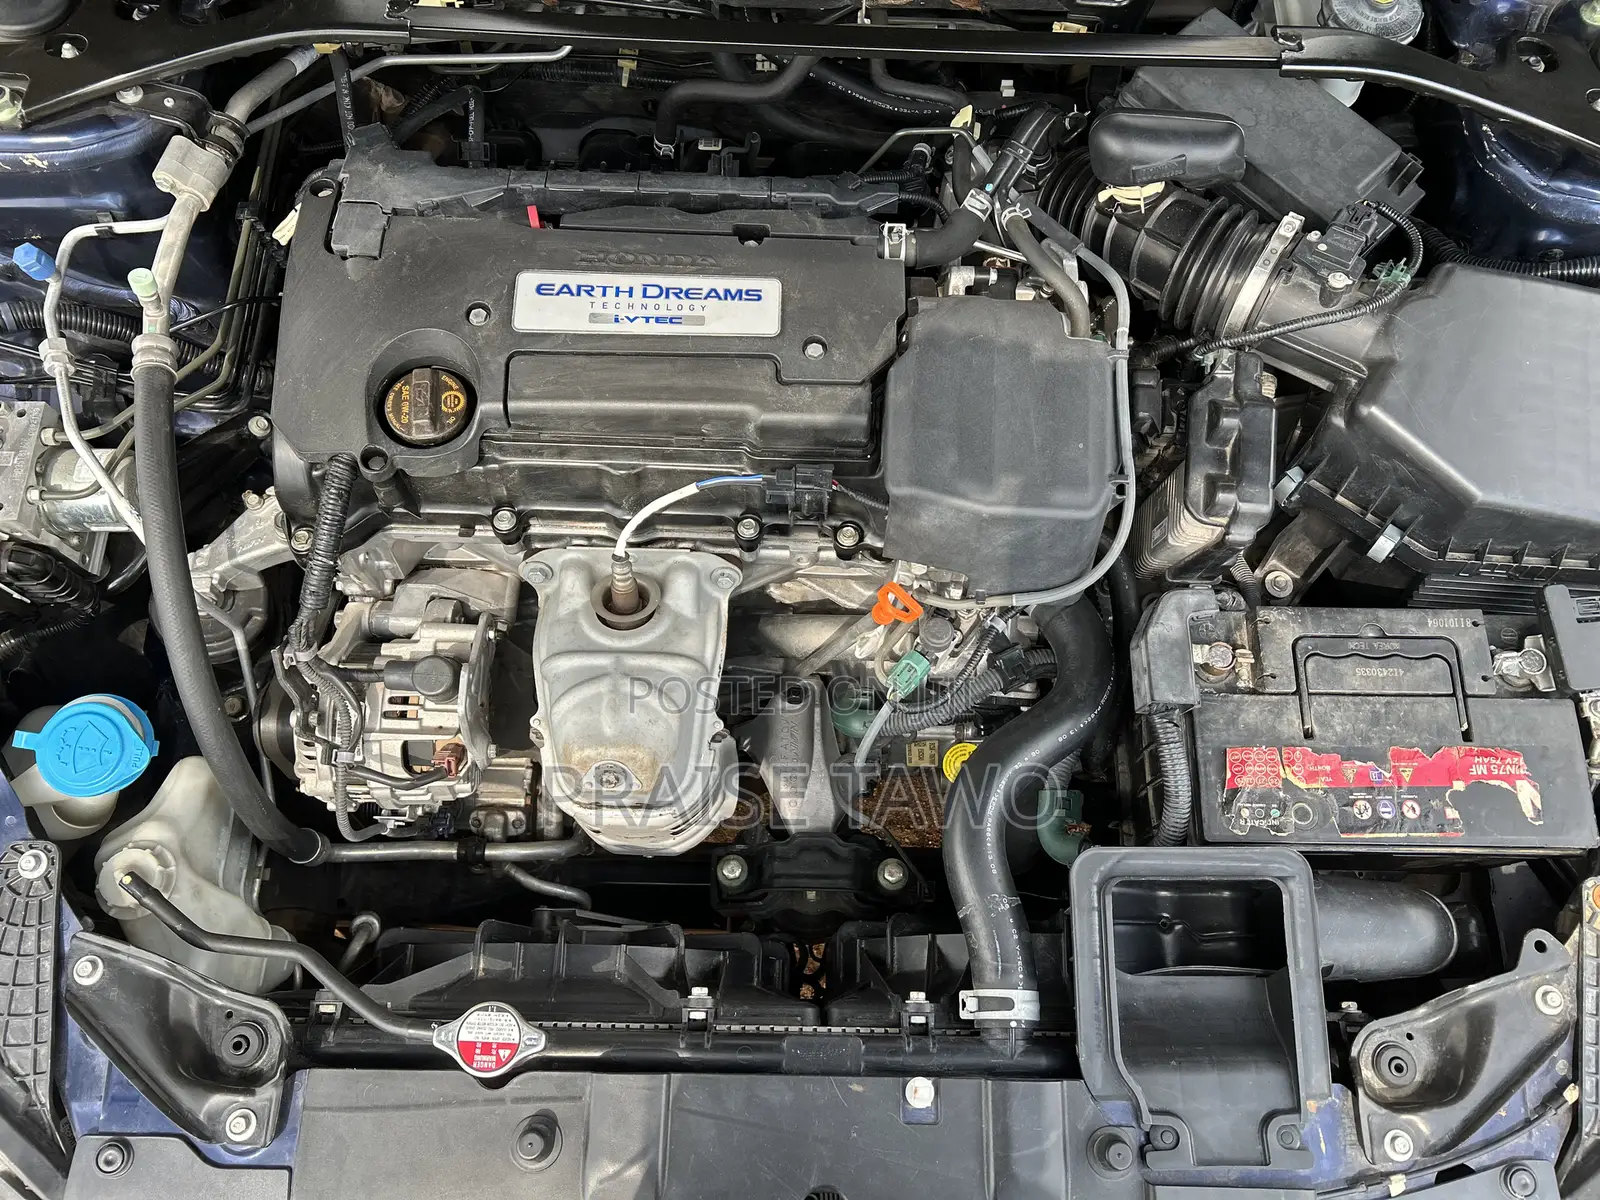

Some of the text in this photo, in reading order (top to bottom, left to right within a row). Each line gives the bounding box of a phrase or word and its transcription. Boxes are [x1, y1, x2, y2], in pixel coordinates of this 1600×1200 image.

[576, 251, 719, 266] HONDA
[535, 283, 763, 302] EARTH DREAMS
[590, 301, 708, 312] TECHNOLOGY
[613, 314, 683, 325] i-VTEC
[400, 385, 410, 424] SAE 0W-20
[1373, 641, 1400, 650] KOREA
[131, 740, 144, 769] PULL
[1474, 756, 1501, 764] 75AH
[1469, 764, 1487, 774] MF
